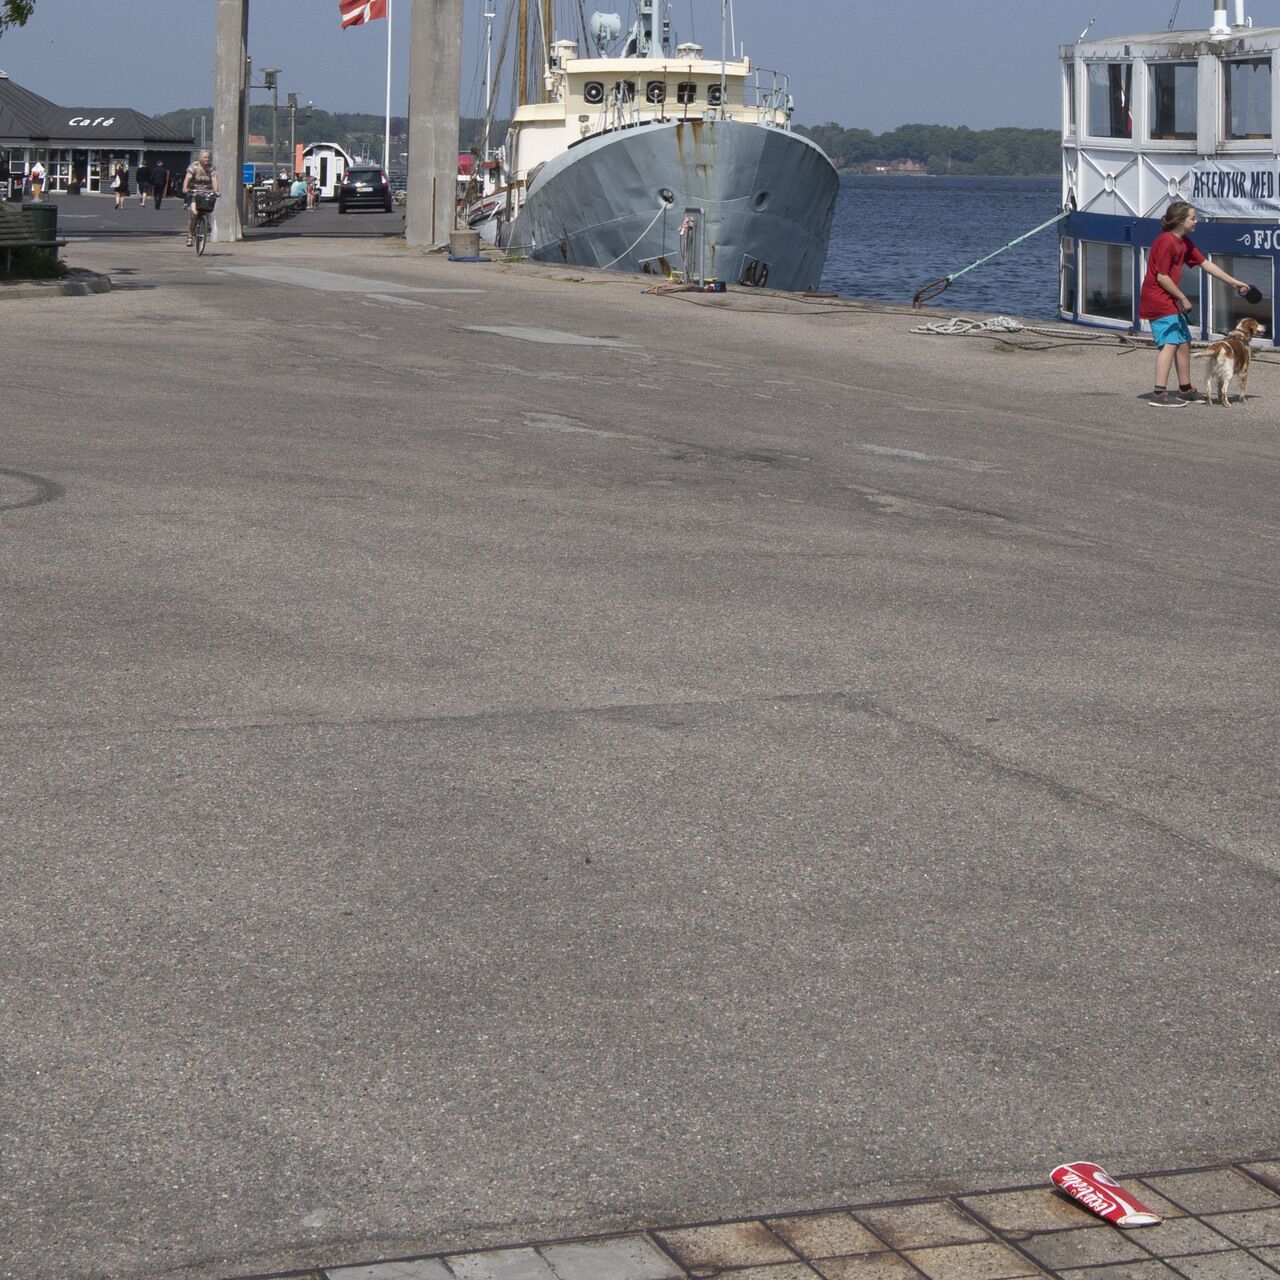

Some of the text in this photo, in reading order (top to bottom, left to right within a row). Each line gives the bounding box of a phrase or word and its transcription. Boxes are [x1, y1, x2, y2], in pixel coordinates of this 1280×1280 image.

[69, 117, 115, 126] Café
[1192, 170, 1247, 199] AFTENTUR
[1249, 170, 1274, 199] MED
